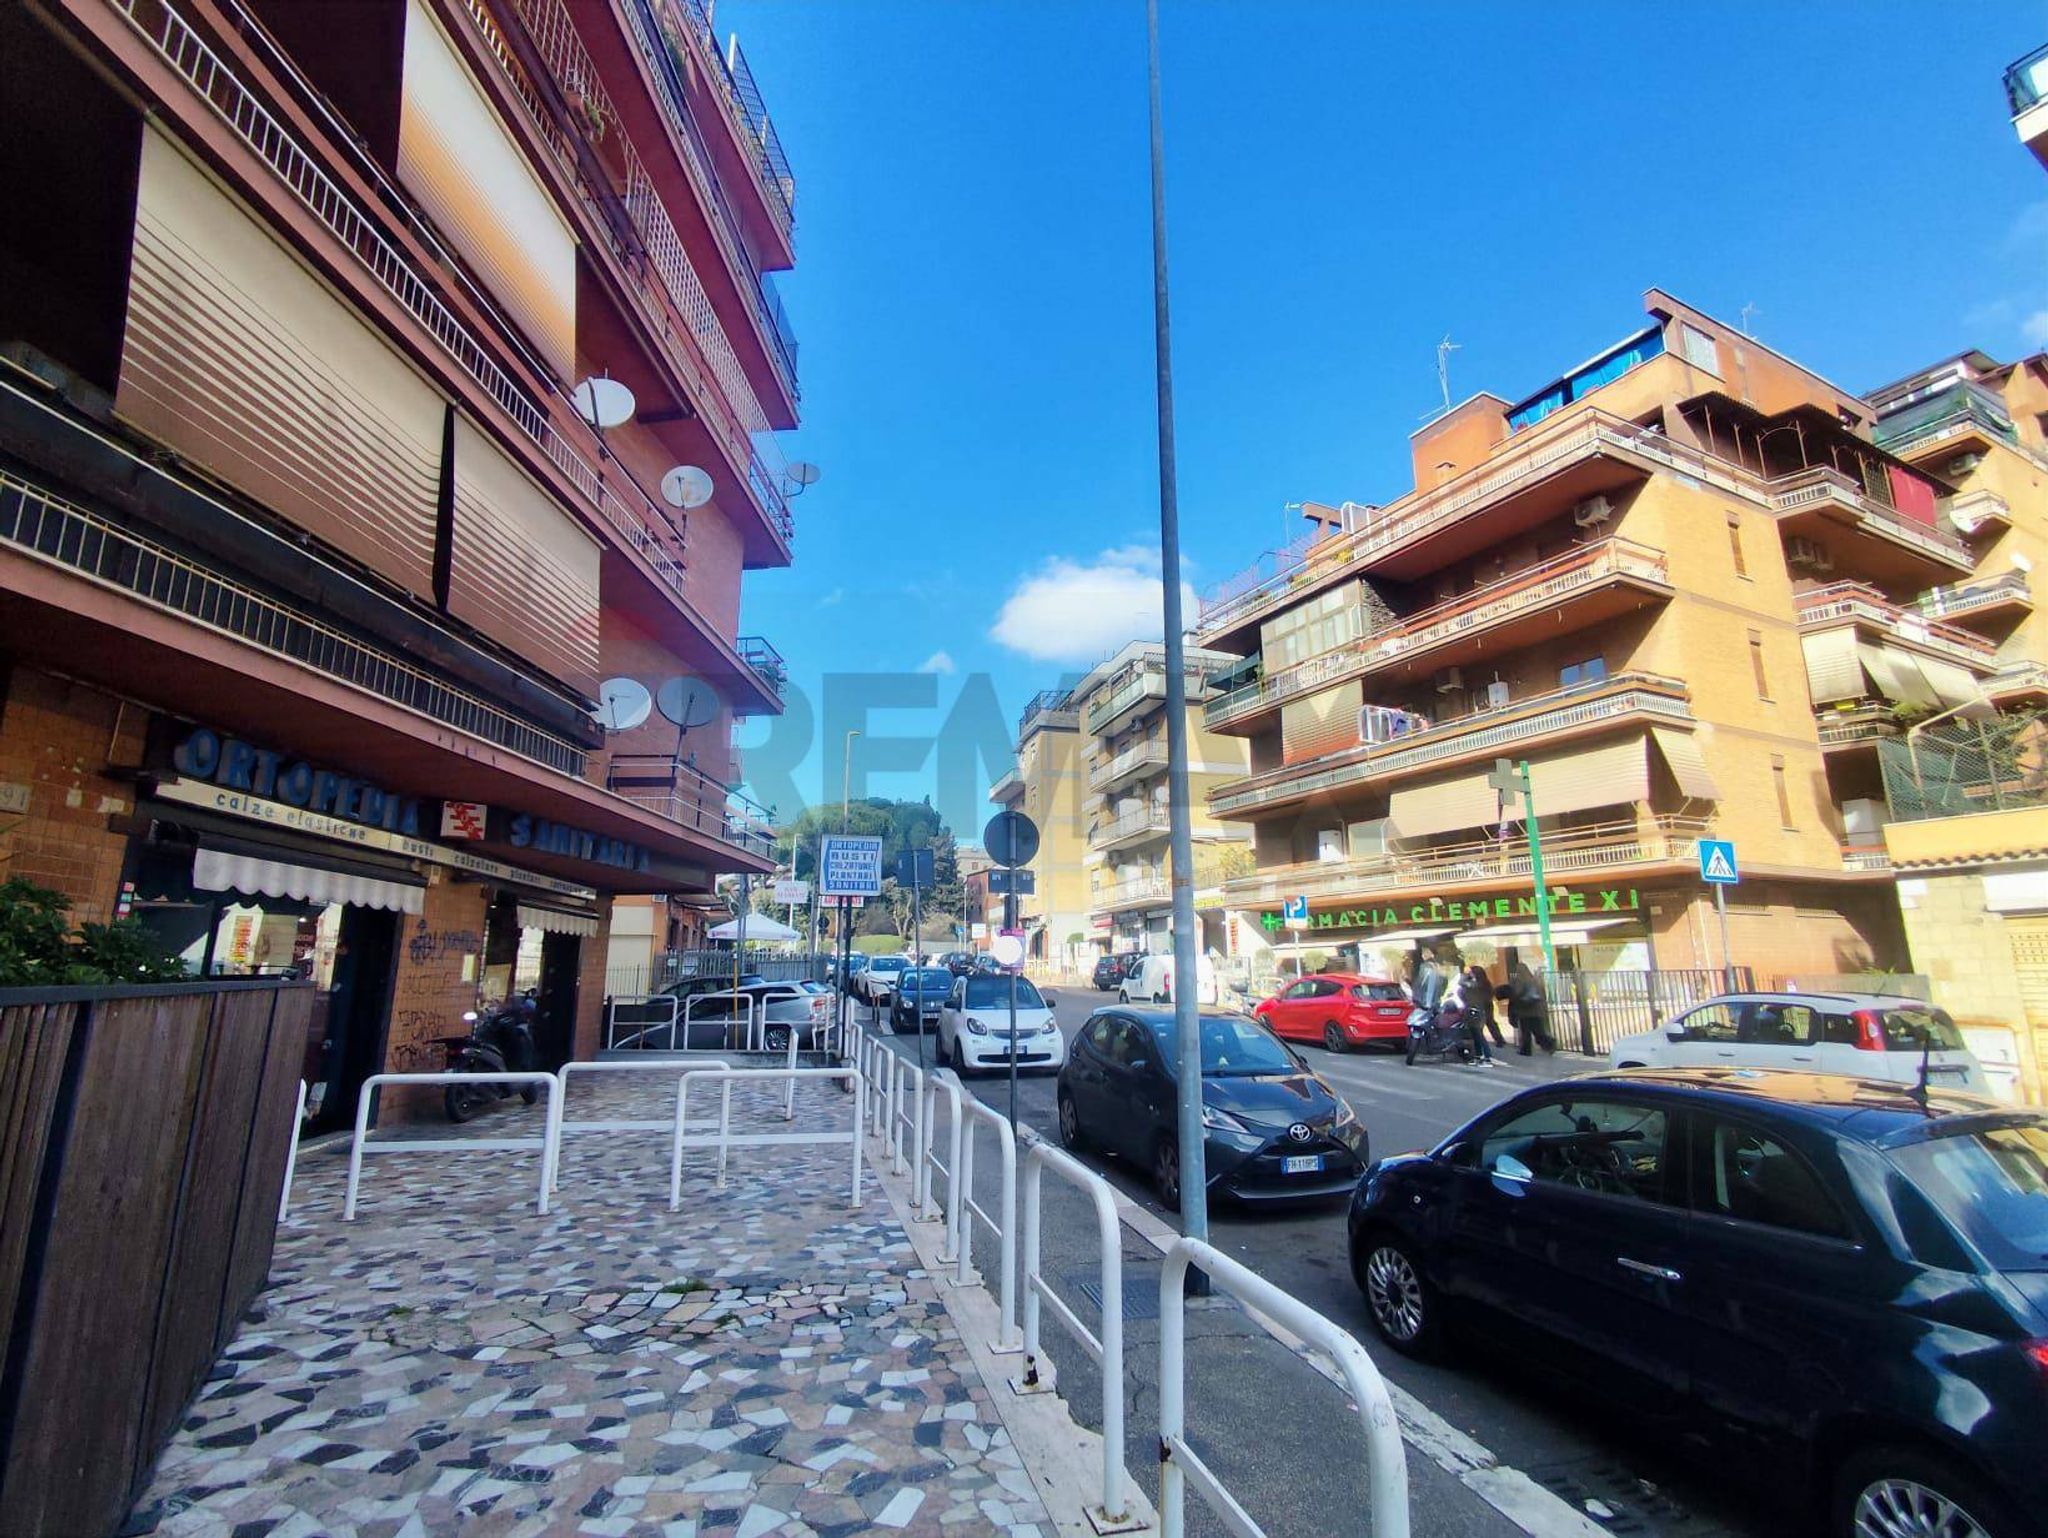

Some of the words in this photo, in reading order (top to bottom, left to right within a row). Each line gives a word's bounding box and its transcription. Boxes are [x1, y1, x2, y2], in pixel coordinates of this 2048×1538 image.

[174, 728, 420, 836] ORTOPEDIA
[215, 793, 275, 819] calze
[286, 811, 367, 841] elastiche
[509, 811, 650, 873] SANITARIA
[830, 851, 875, 861] BUSTI
[1274, 908, 1399, 931] FRMACIA
[1410, 892, 1587, 923] CLEMENTE
[1600, 889, 1639, 912] XI
